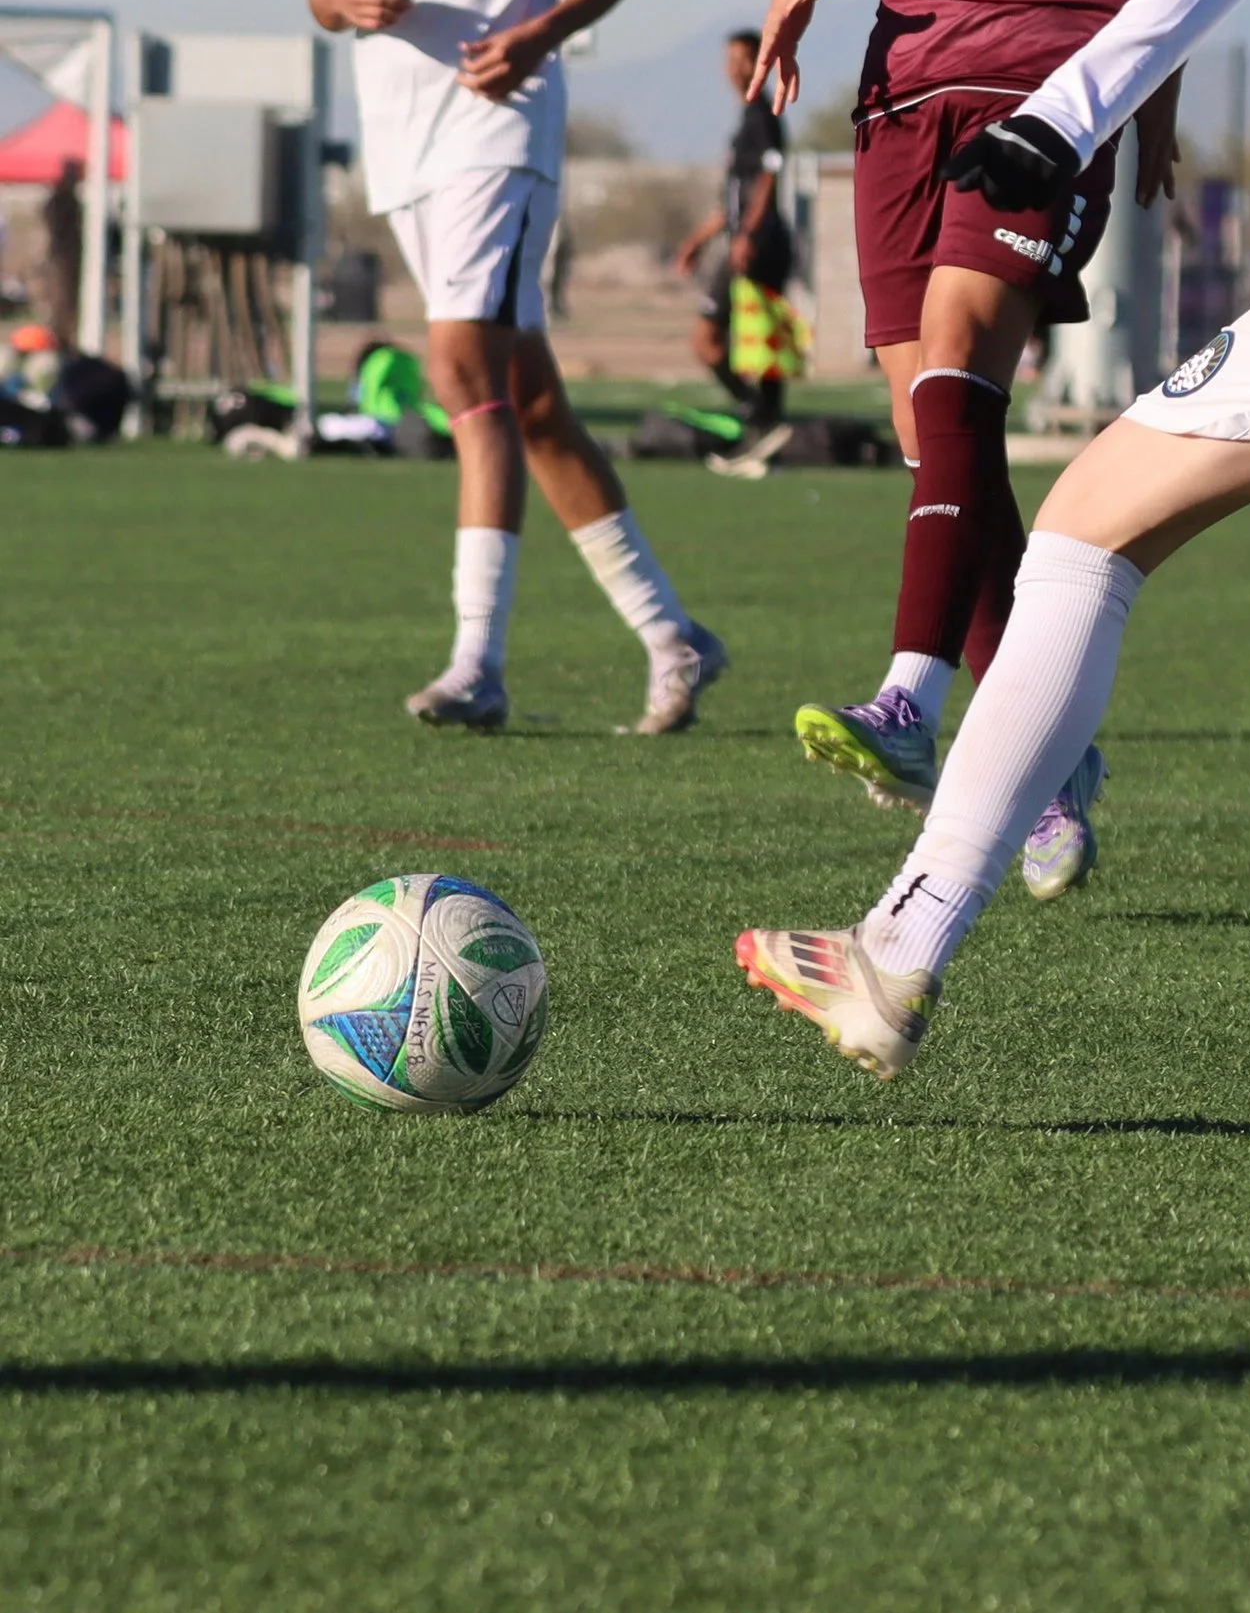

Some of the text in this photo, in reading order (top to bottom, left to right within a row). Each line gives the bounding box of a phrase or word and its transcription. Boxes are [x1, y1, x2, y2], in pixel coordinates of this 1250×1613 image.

[993, 228, 1054, 259] capelli
[417, 961, 437, 998] MLS
[408, 1007, 430, 1049] NEXT
